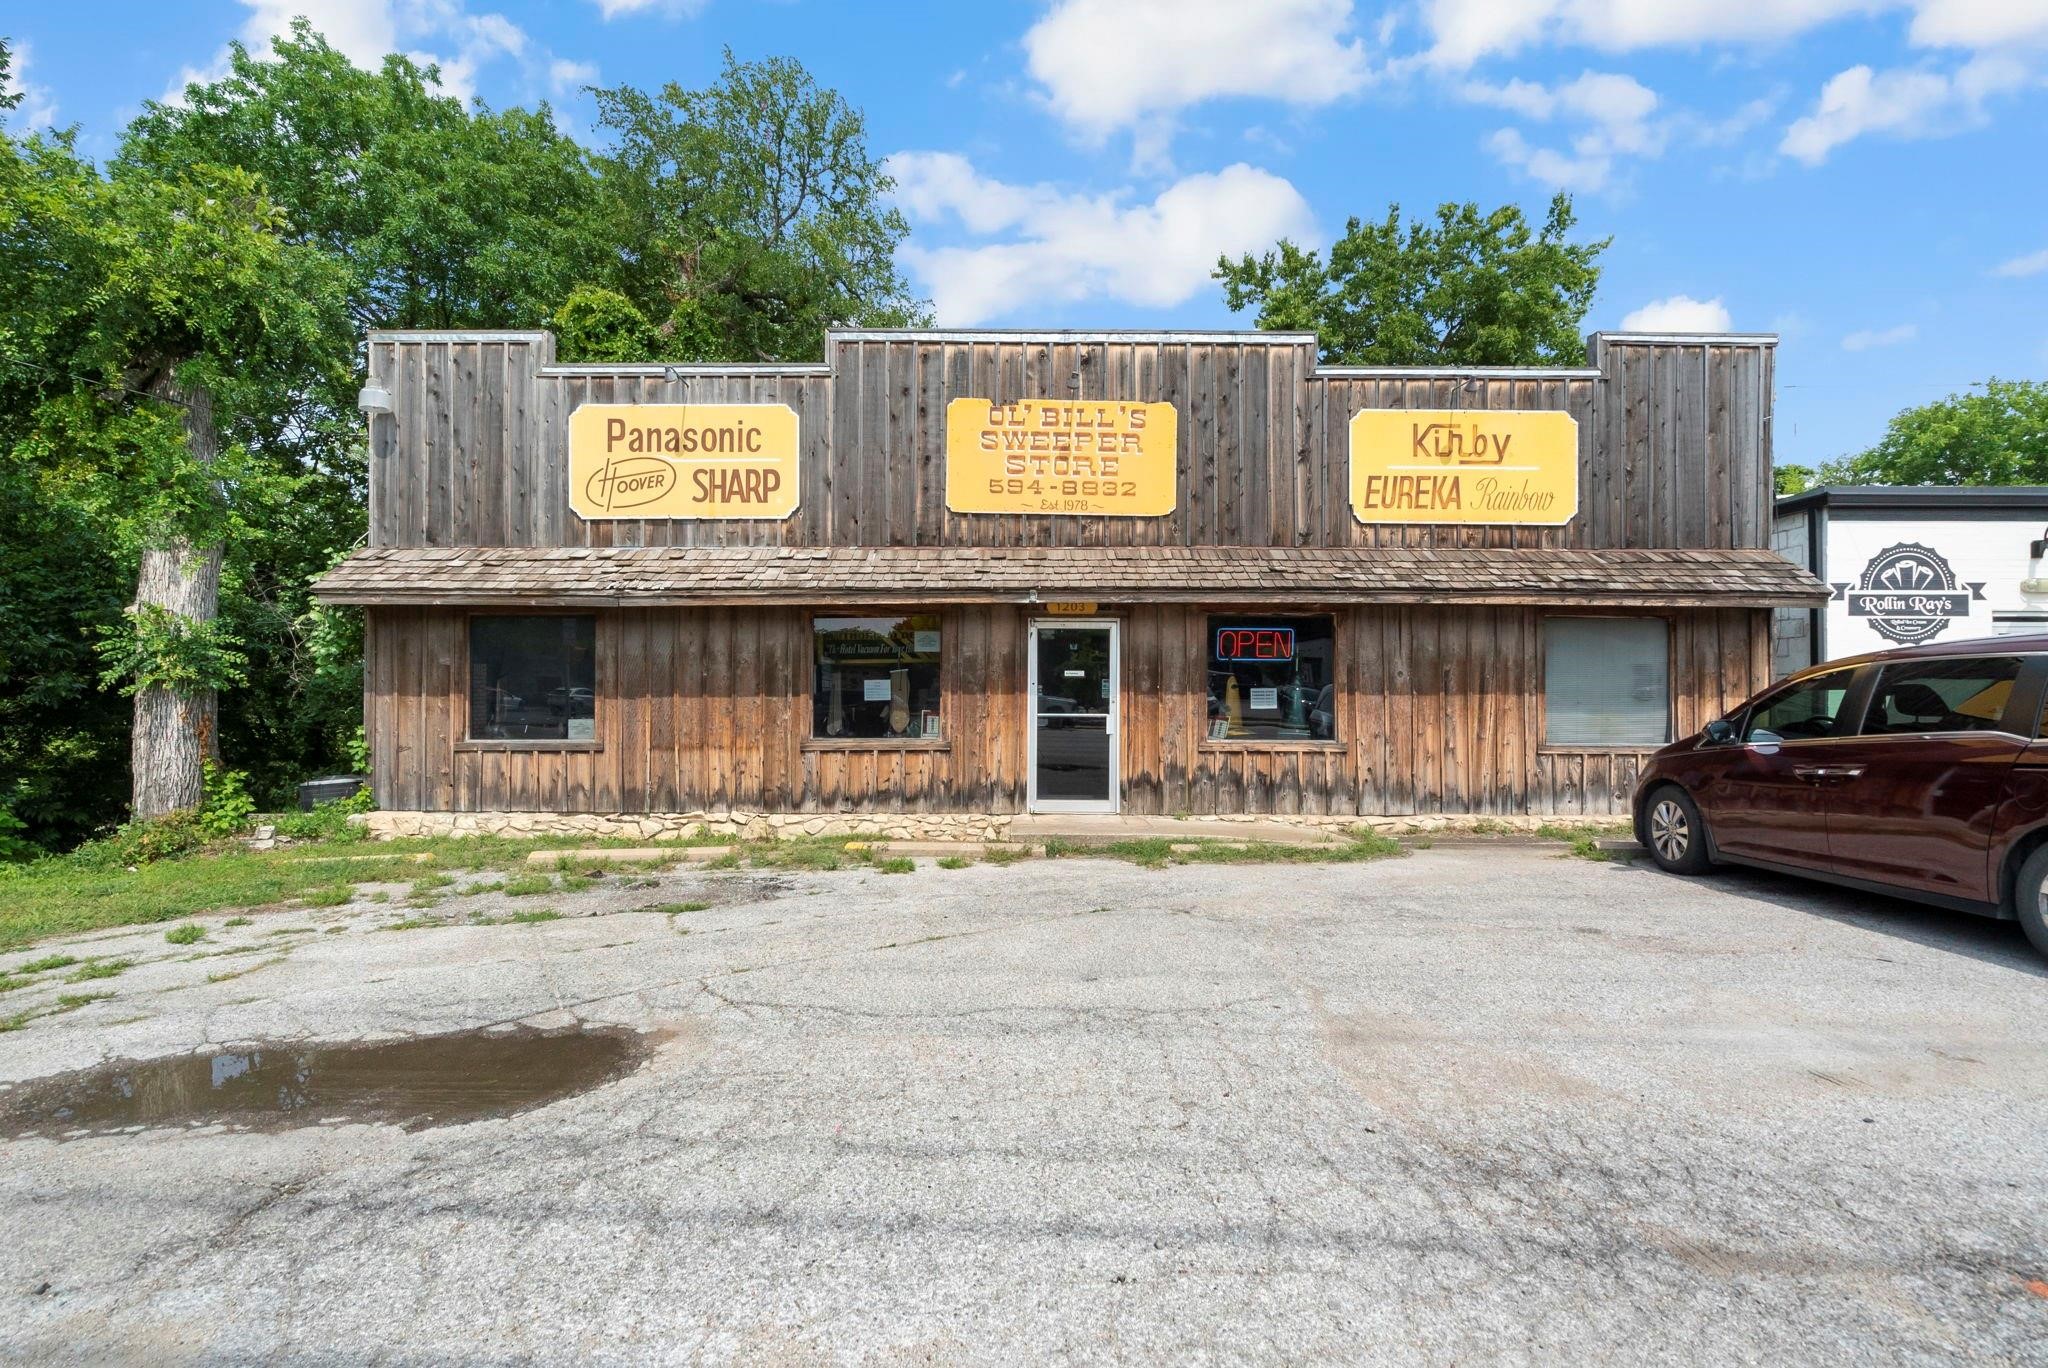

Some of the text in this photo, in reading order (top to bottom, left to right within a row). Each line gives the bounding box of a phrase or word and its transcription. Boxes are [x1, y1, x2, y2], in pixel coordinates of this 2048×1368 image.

[989, 404, 1147, 429] OL' BILL'S
[606, 418, 762, 453] Panasonic
[980, 430, 1144, 453] SWEEPER
[1412, 423, 1512, 465] Kirby
[1006, 454, 1119, 477] STORE
[598, 457, 781, 512] HOOVER SHARP
[989, 478, 1137, 497] 594-8832
[1363, 475, 1556, 511] EUREKA Rainbow
[1063, 499, 1089, 511] 1978
[1057, 602, 1086, 612] 1203
[1859, 596, 1952, 616] Rollin Ray's
[1219, 630, 1291, 658] OPEN
